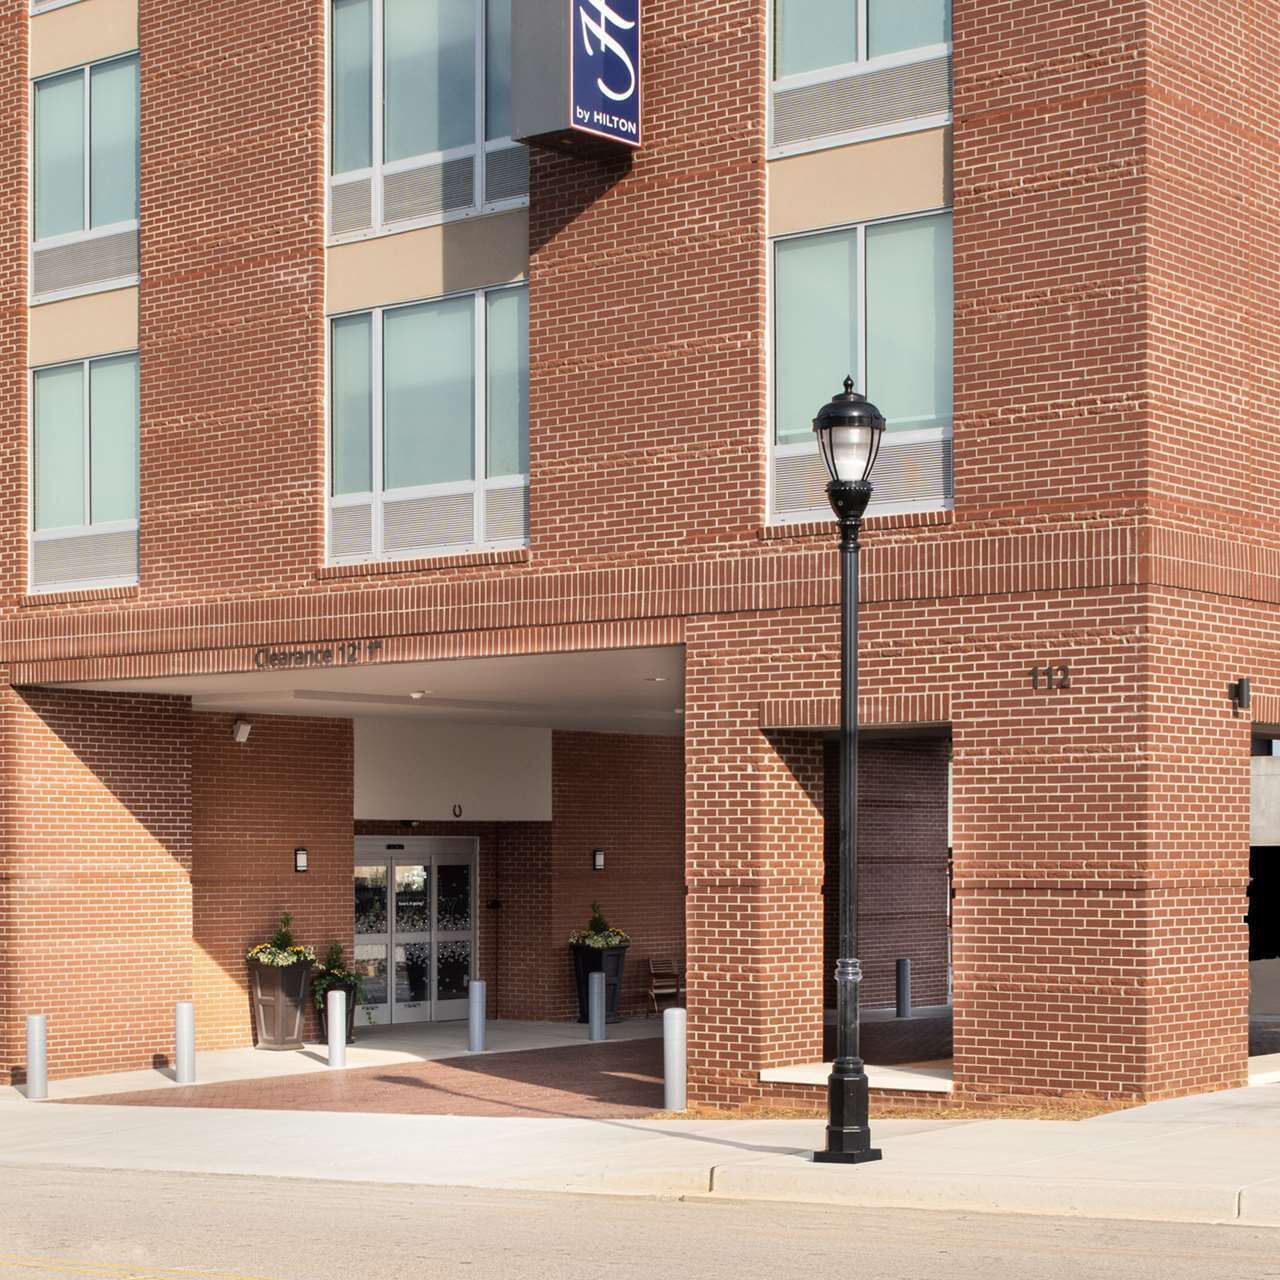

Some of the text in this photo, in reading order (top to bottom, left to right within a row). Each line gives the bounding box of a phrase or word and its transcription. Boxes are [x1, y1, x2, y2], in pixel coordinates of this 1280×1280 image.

[576, 106, 637, 135] by HILTON
[255, 646, 333, 668] Clearance
[1028, 665, 1071, 690] 112
